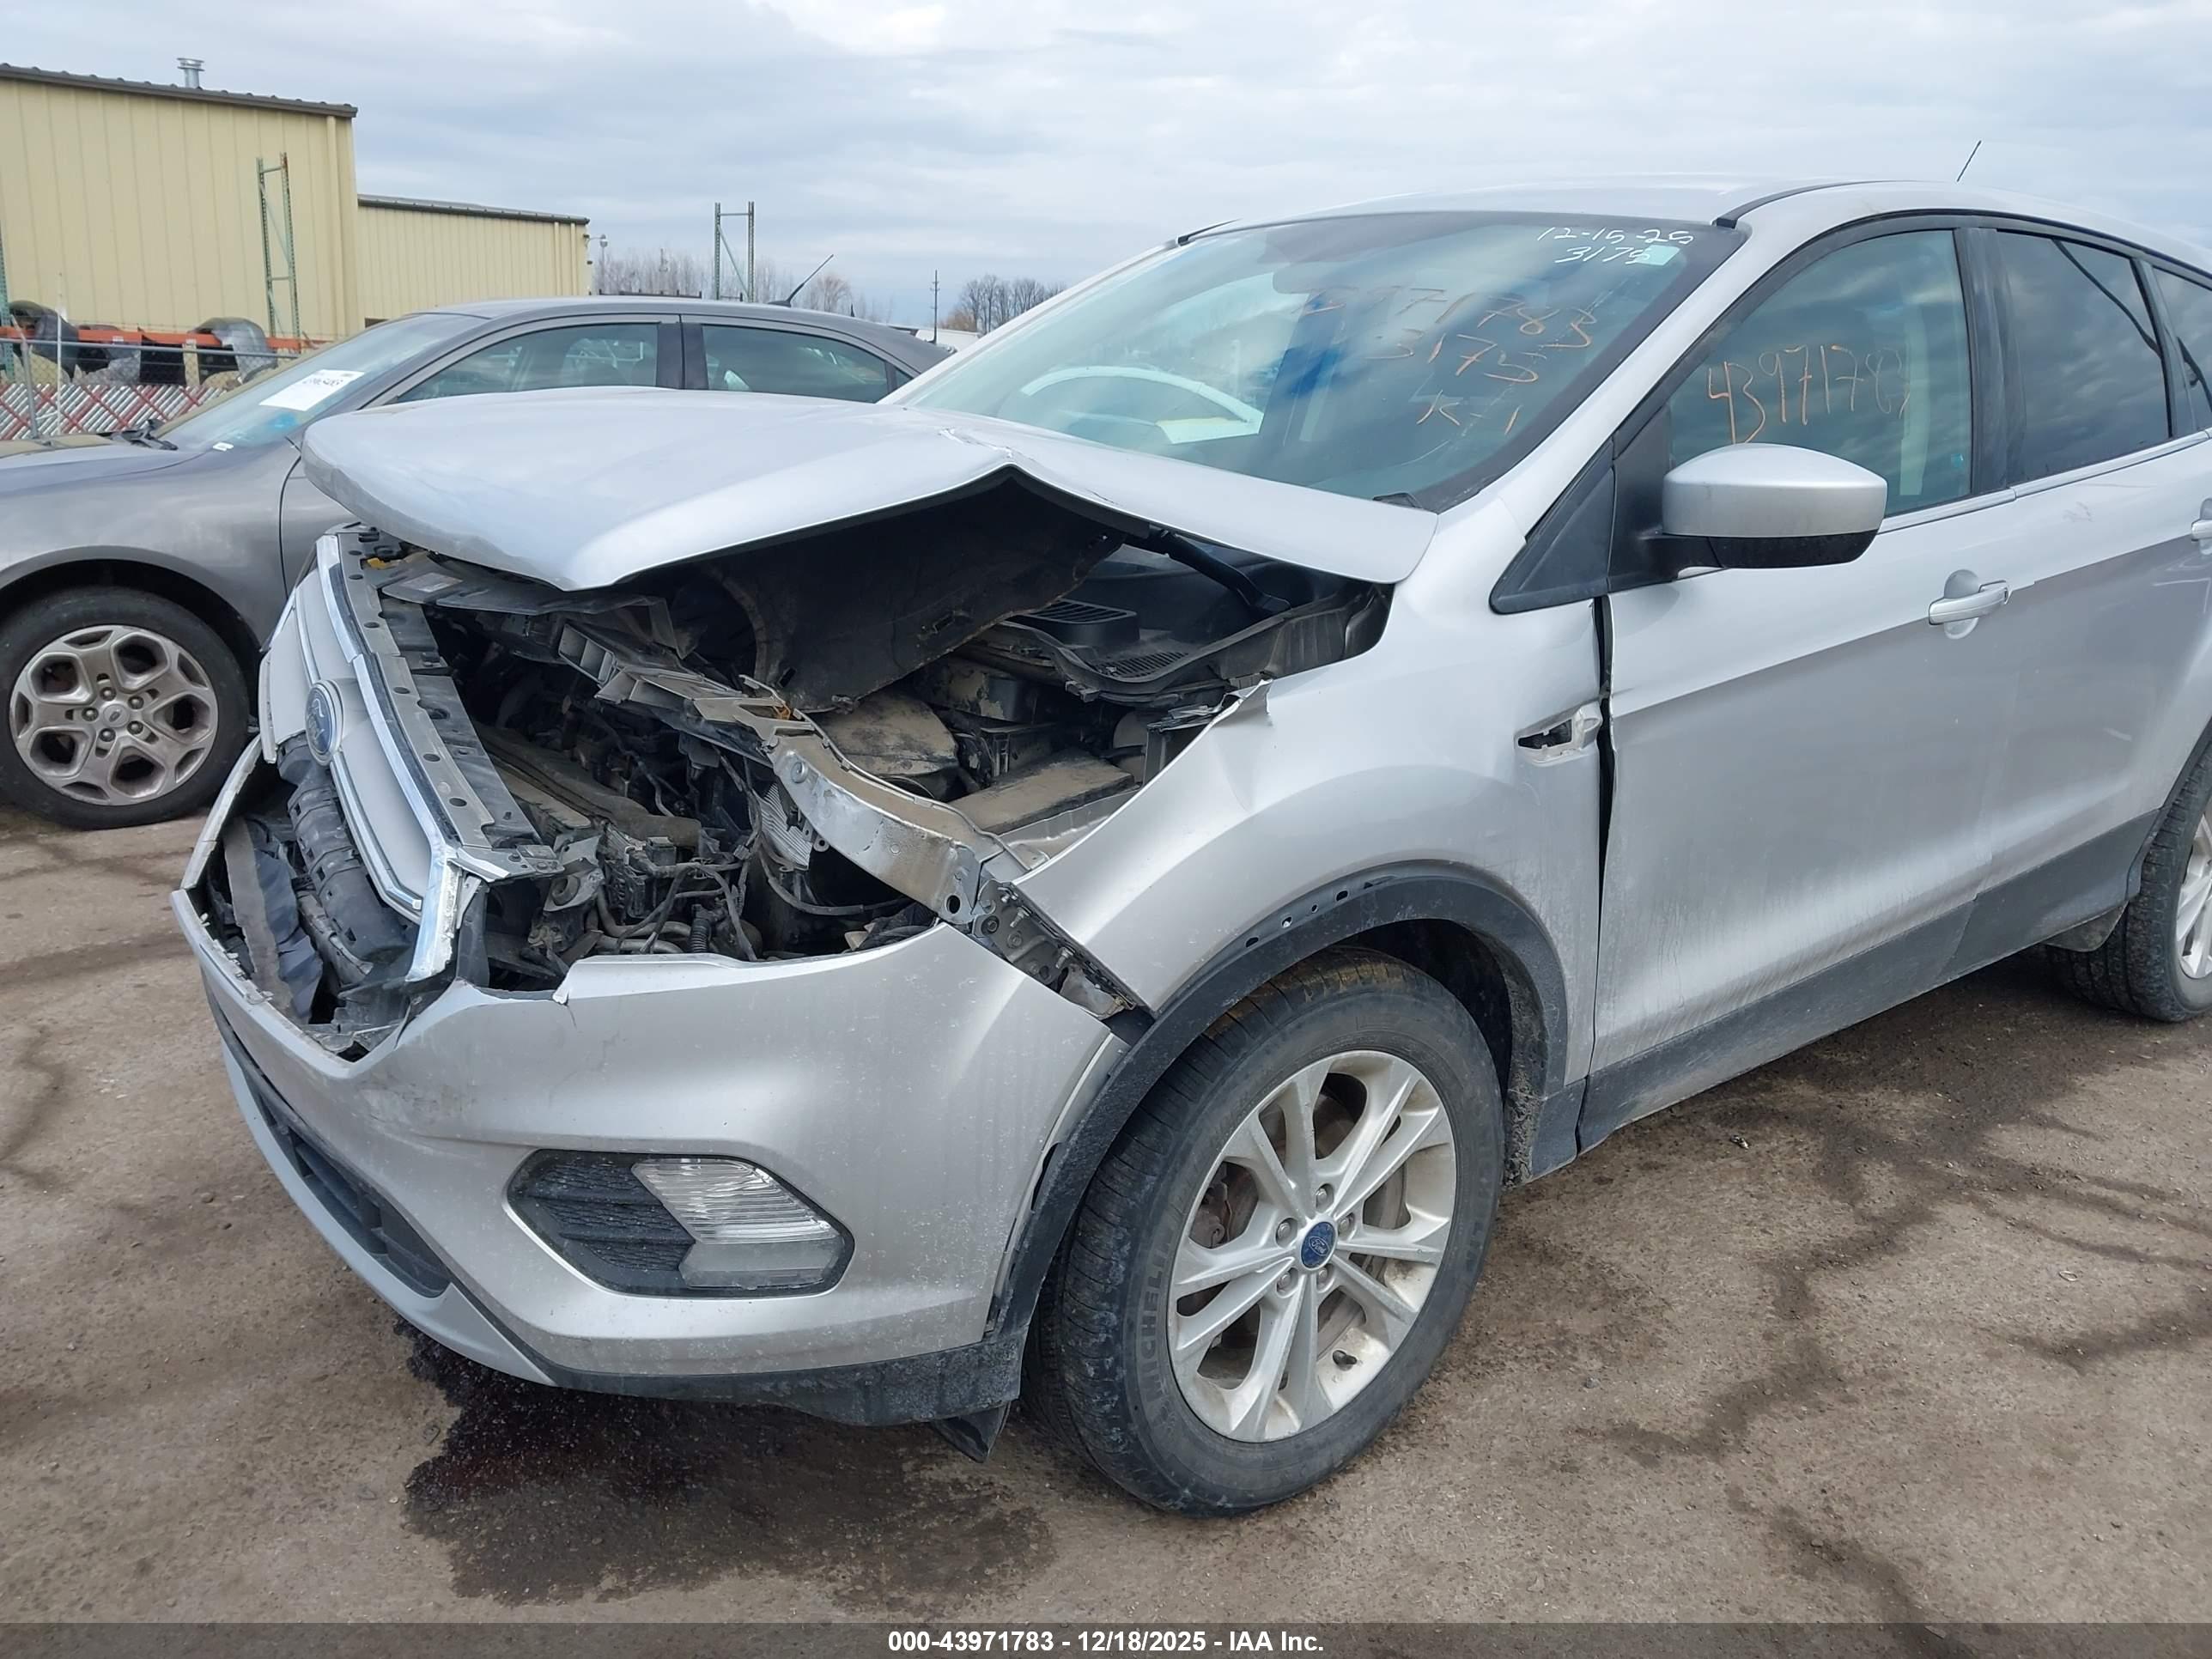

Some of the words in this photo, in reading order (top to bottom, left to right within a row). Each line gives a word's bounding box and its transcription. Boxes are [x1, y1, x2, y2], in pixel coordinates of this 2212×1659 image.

[1536, 227, 1693, 245] 12-15-25
[1554, 246, 1651, 264] 3175
[1139, 1226, 1173, 1404] MICHELI
